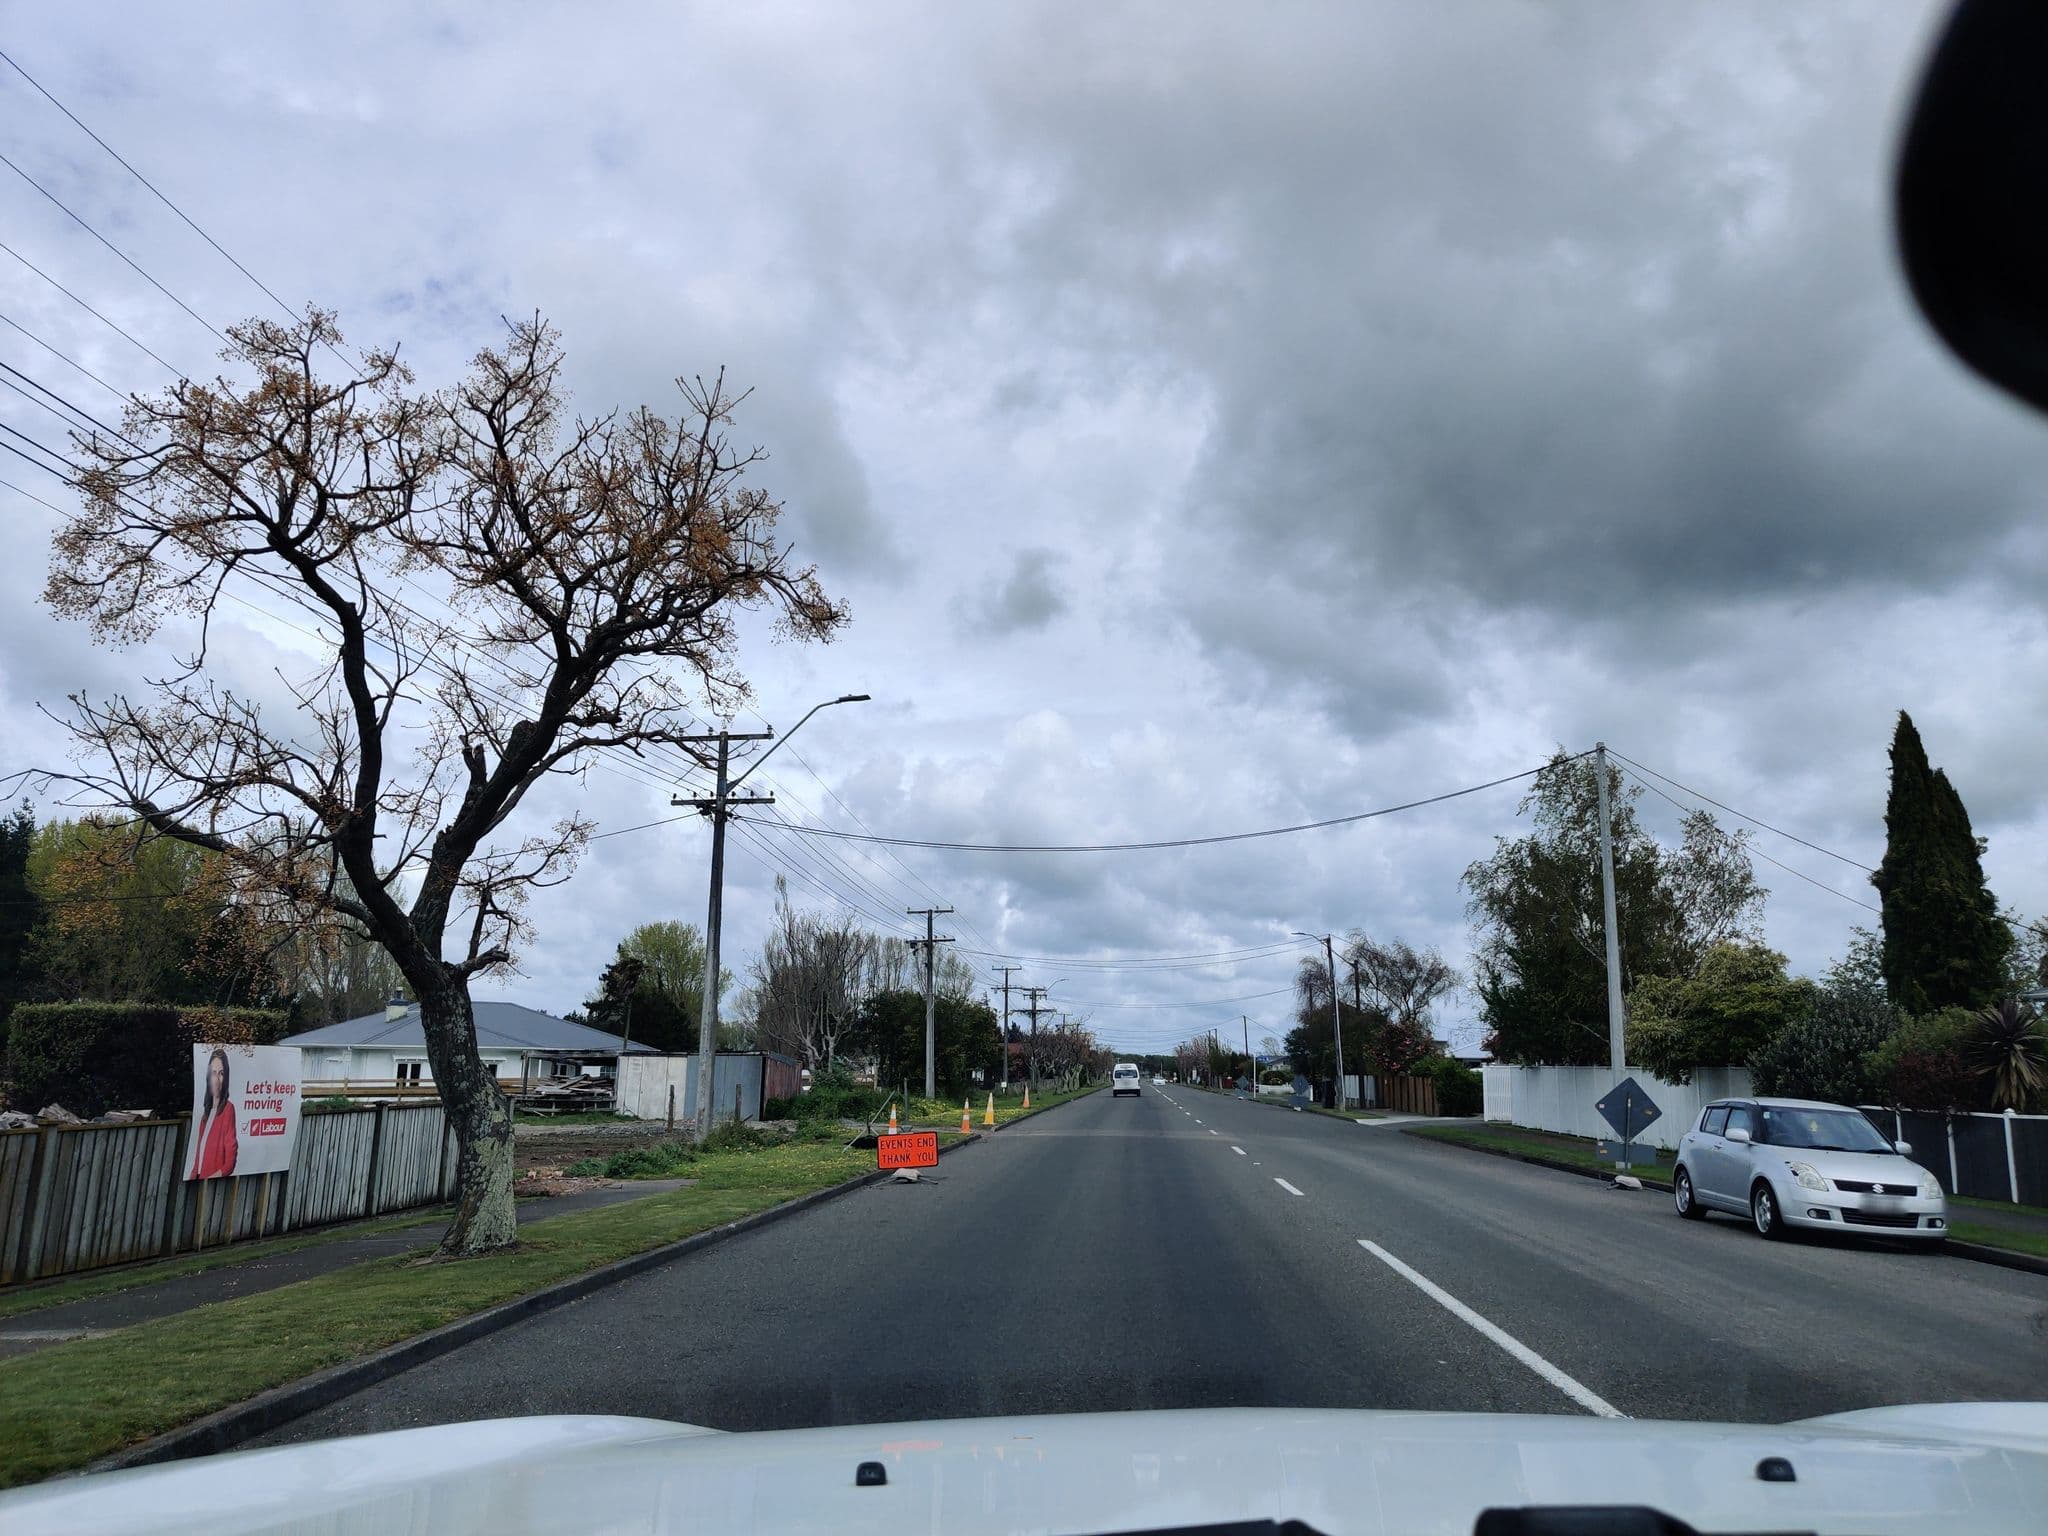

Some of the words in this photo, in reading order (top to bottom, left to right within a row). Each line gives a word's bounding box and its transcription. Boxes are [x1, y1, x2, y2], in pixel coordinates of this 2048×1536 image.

[246, 1080, 272, 1094] Let's
[273, 1080, 296, 1095] keep
[244, 1096, 283, 1112] moving
[262, 1122, 285, 1132] Labour
[880, 1139, 912, 1149] EVENTS
[917, 1137, 935, 1147] END
[882, 1154, 911, 1163] THANK
[917, 1152, 934, 1161] YOU
